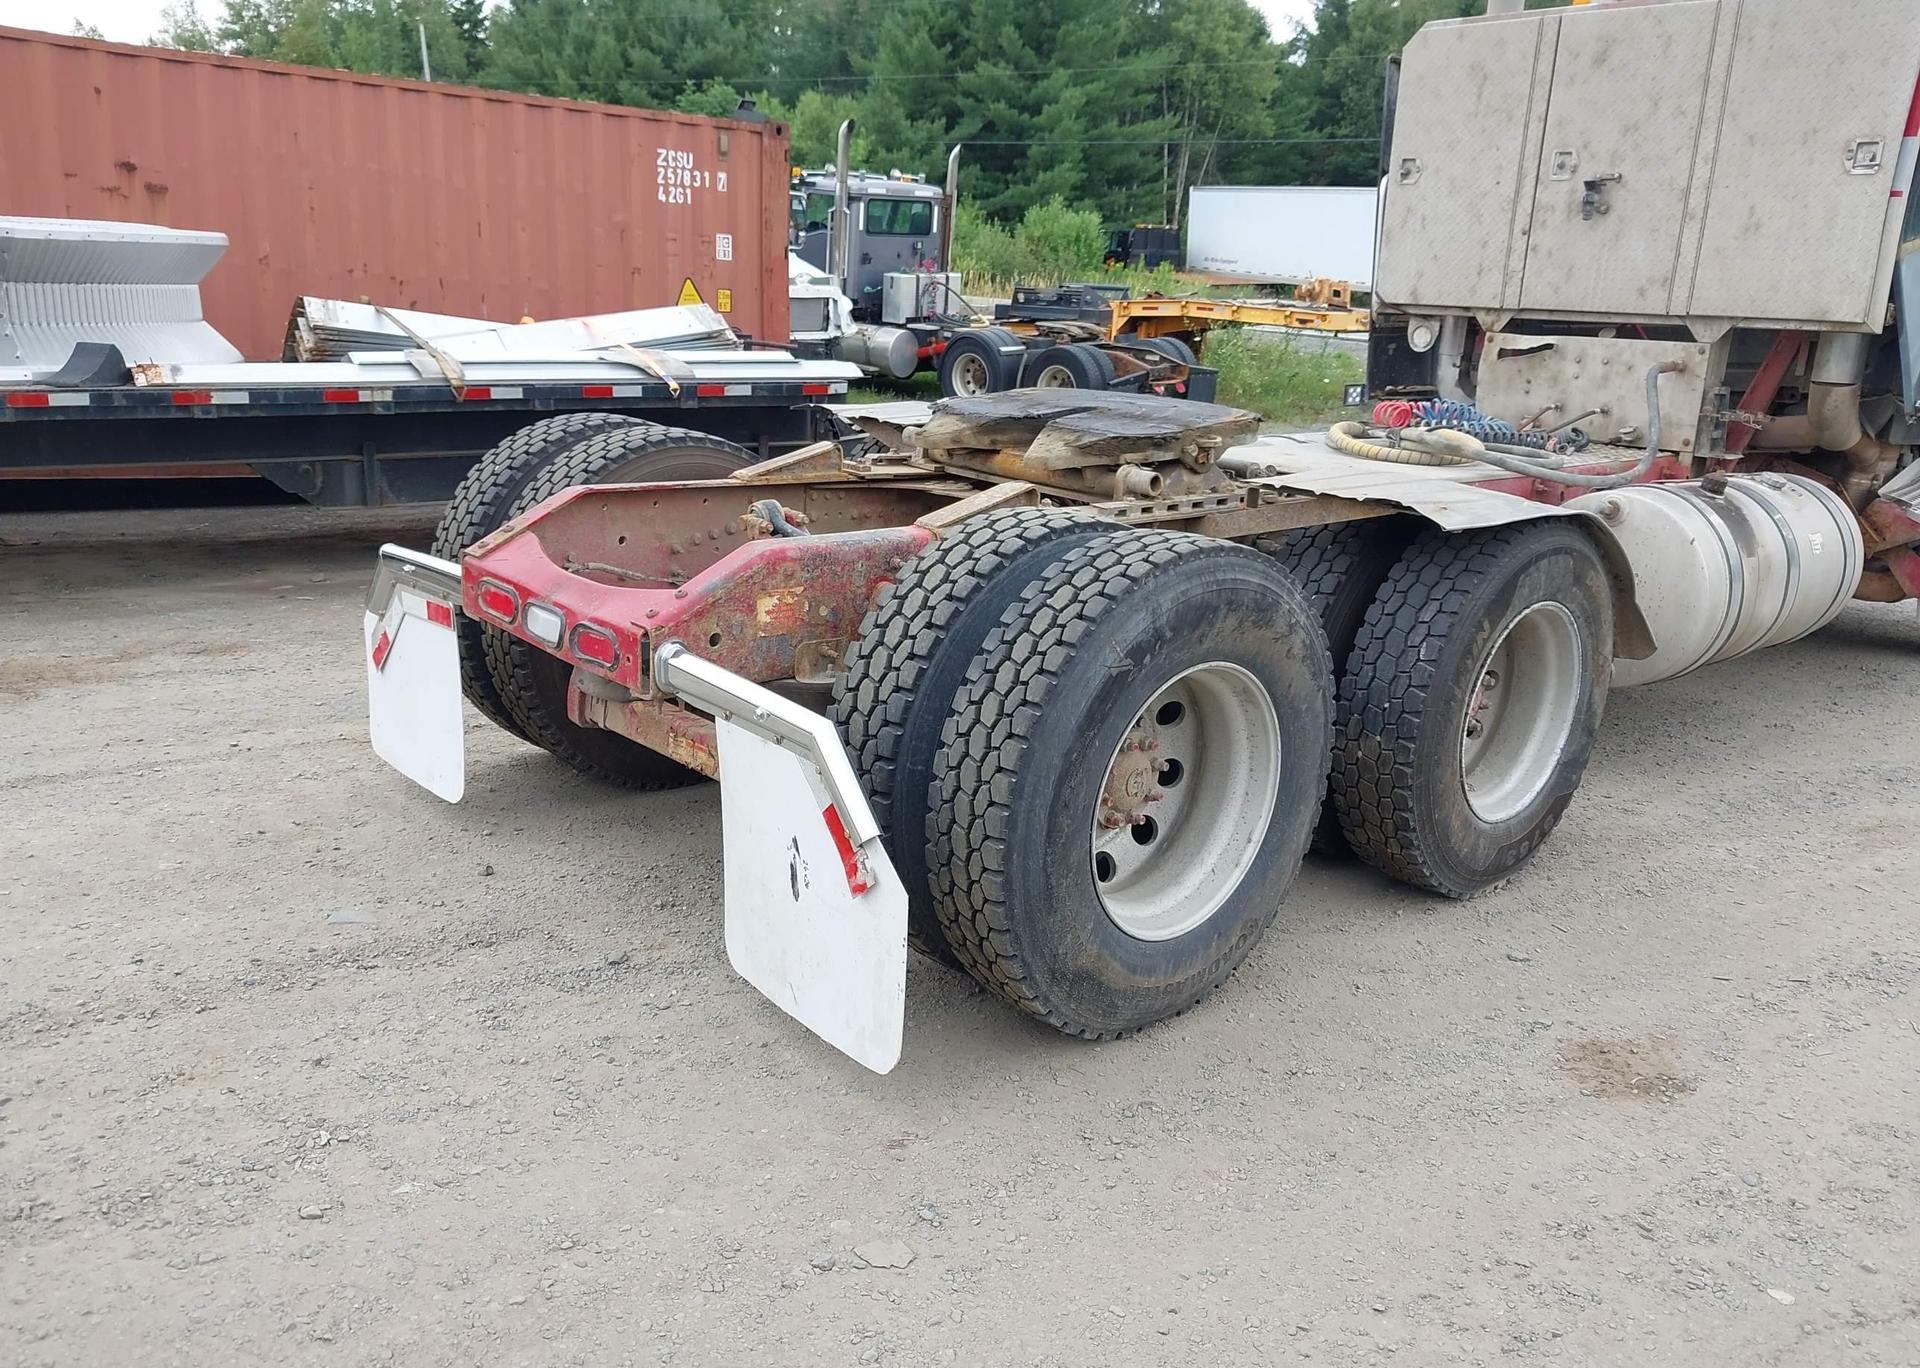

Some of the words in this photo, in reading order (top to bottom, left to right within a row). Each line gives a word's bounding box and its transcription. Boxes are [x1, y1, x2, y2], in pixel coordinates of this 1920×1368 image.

[656, 148, 693, 169] ZCSU
[657, 167, 709, 188] 257831
[717, 172, 727, 191] 7
[658, 185, 691, 204] 42G1
